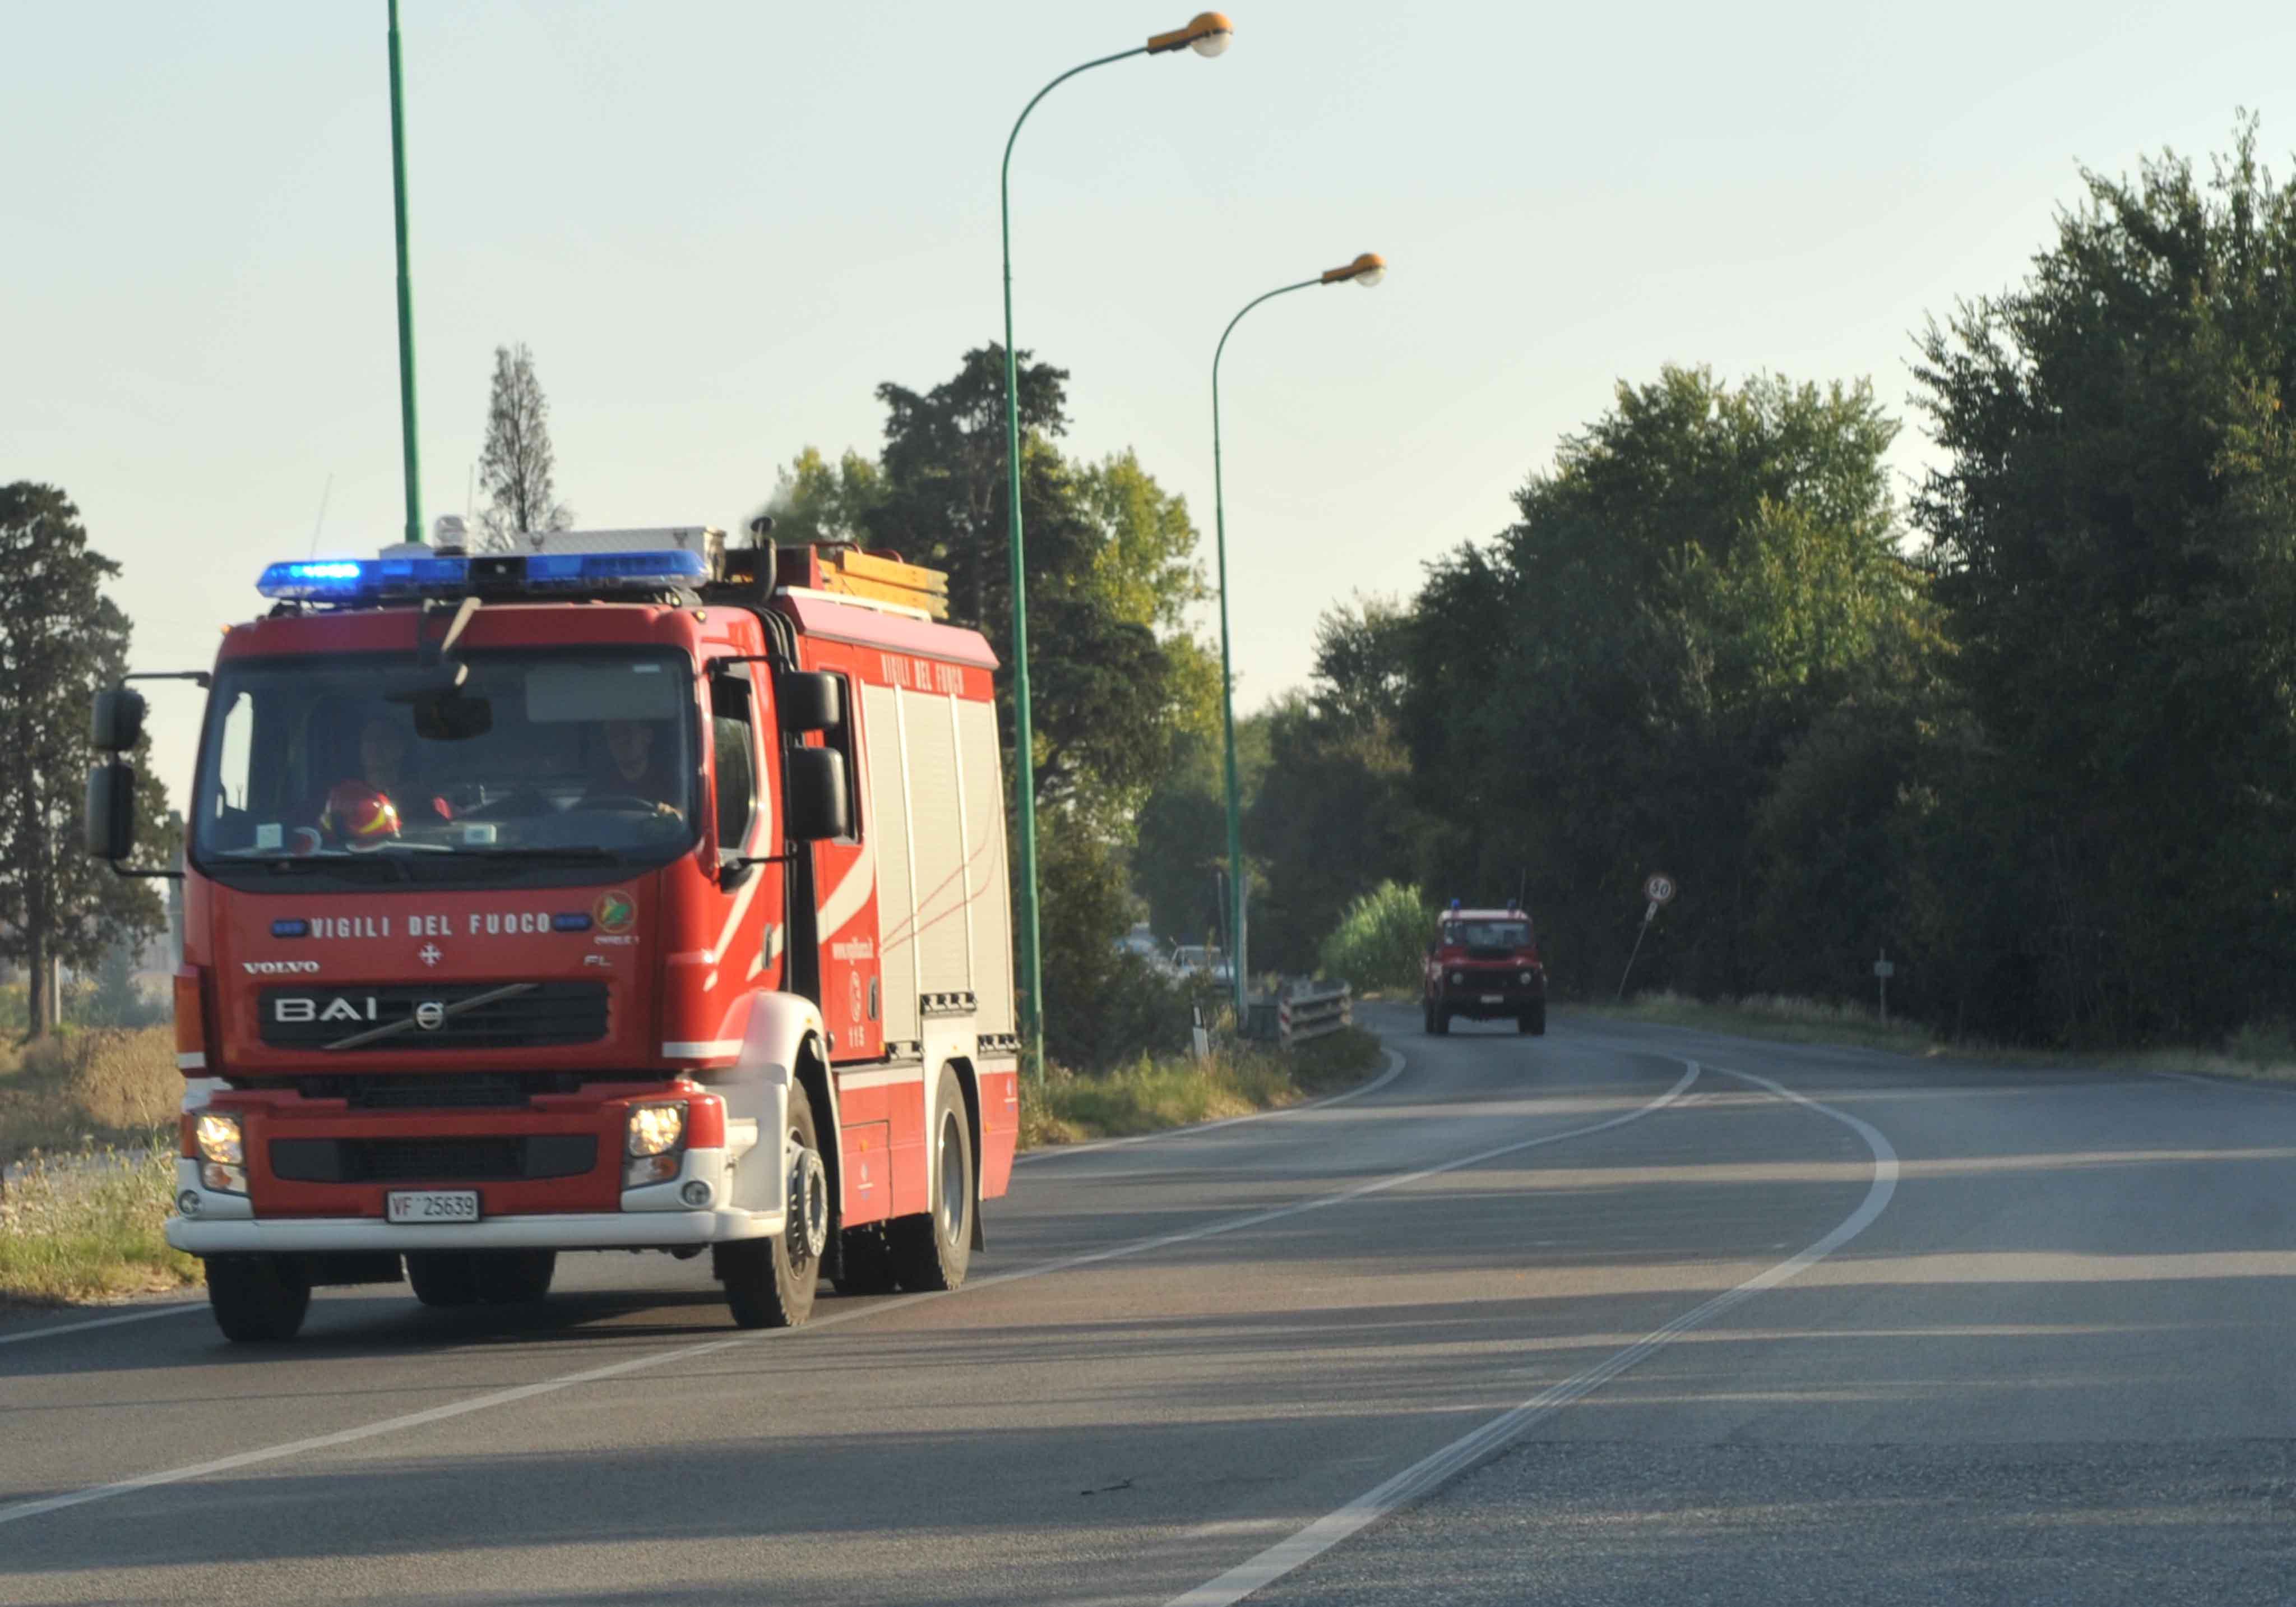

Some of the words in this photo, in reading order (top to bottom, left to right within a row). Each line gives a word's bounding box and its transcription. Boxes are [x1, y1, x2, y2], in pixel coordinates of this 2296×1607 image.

[881, 654, 911, 686] VIGILI
[914, 659, 932, 691] DEL
[1652, 881, 1669, 897] 50
[311, 916, 391, 938] VIGILI
[408, 915, 452, 936] DEL
[468, 913, 551, 934] FUOCO
[242, 960, 321, 975] VOLVO
[583, 954, 613, 966] FL
[275, 996, 377, 1022] BAI
[849, 1025, 865, 1047] 115
[392, 1197, 411, 1215] VF
[424, 1195, 474, 1216] 25639
